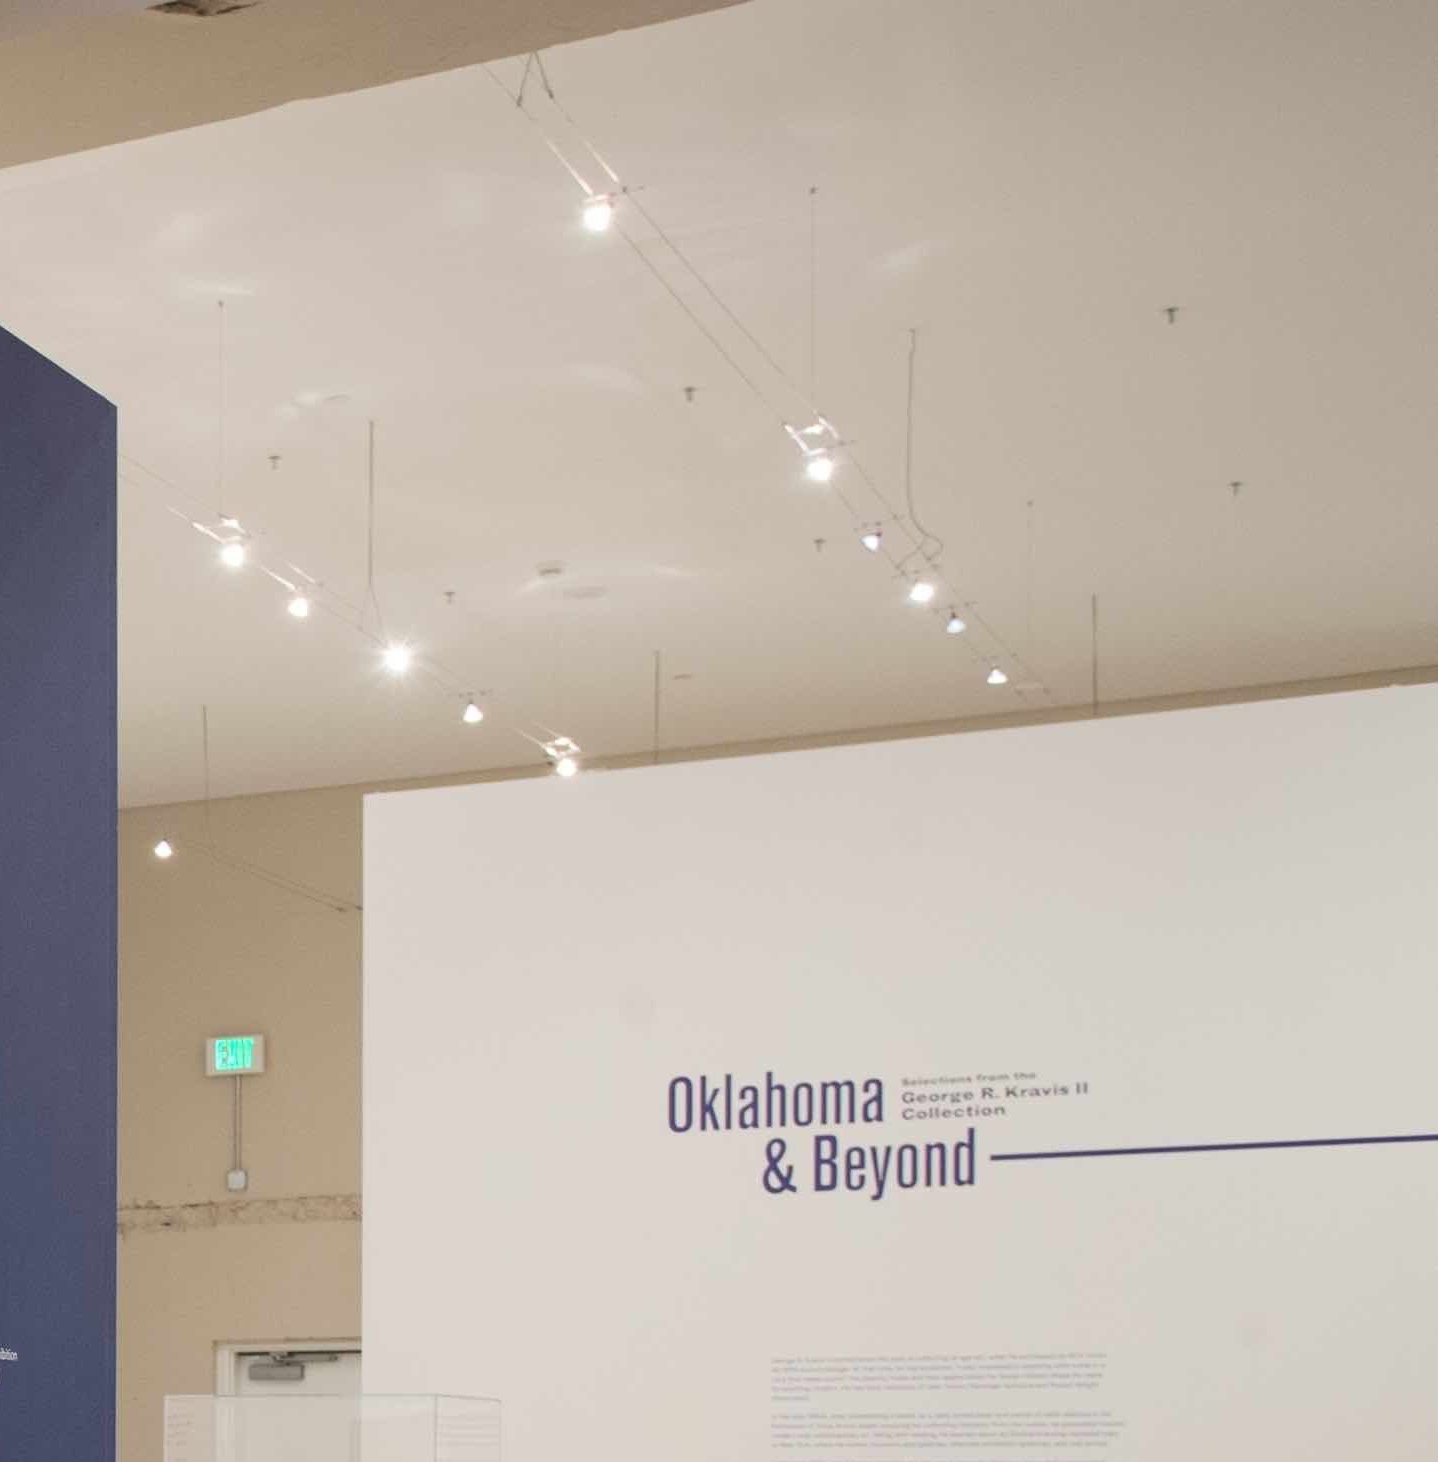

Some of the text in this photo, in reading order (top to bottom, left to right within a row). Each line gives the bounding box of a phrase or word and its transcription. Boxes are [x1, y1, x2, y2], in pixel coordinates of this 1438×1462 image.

[668, 1071, 884, 1133] Oklahoma
[901, 1082, 1088, 1104] George R. Kravis II
[901, 1104, 1006, 1120] Collection
[762, 1127, 976, 1201] & Beyond
